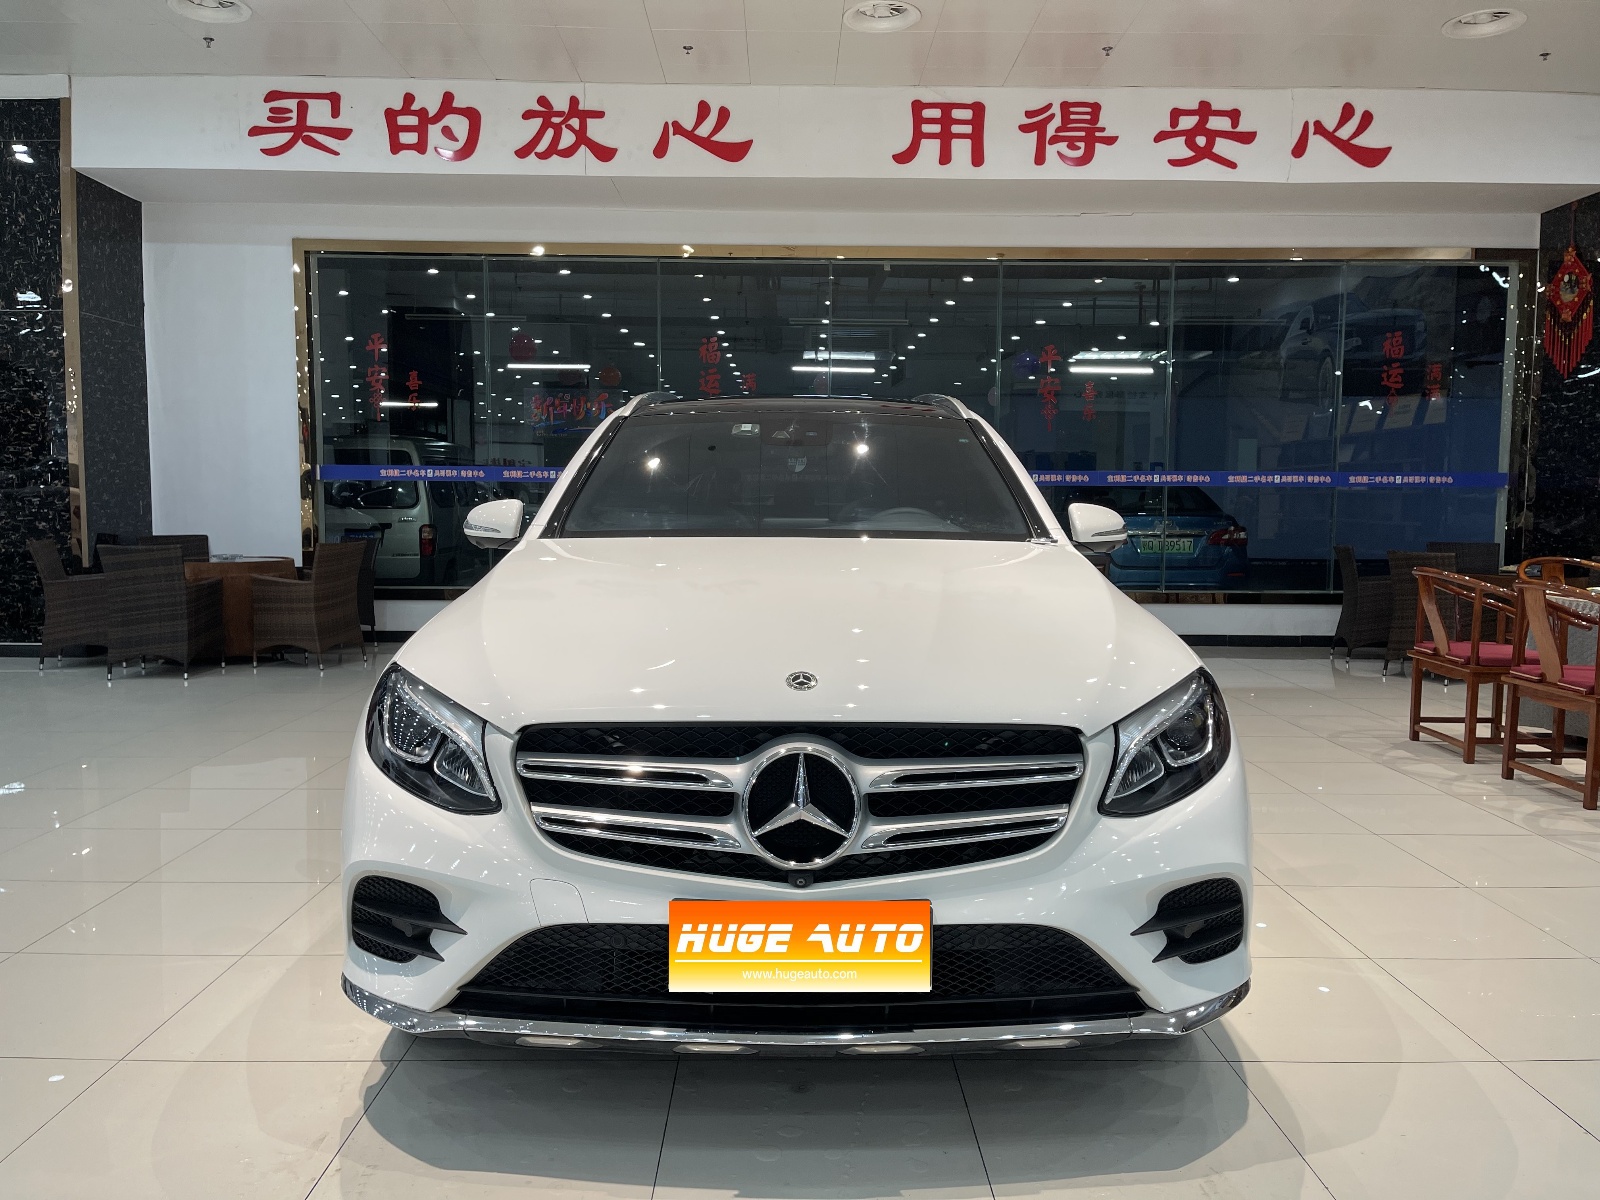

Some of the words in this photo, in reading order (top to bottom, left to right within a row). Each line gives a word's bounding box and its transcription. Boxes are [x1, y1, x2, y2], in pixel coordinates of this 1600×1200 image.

[247, 90, 753, 163] 买的放心
[891, 99, 1393, 170] 用得安心
[698, 336, 721, 395] 福运
[1381, 331, 1405, 389] 福运
